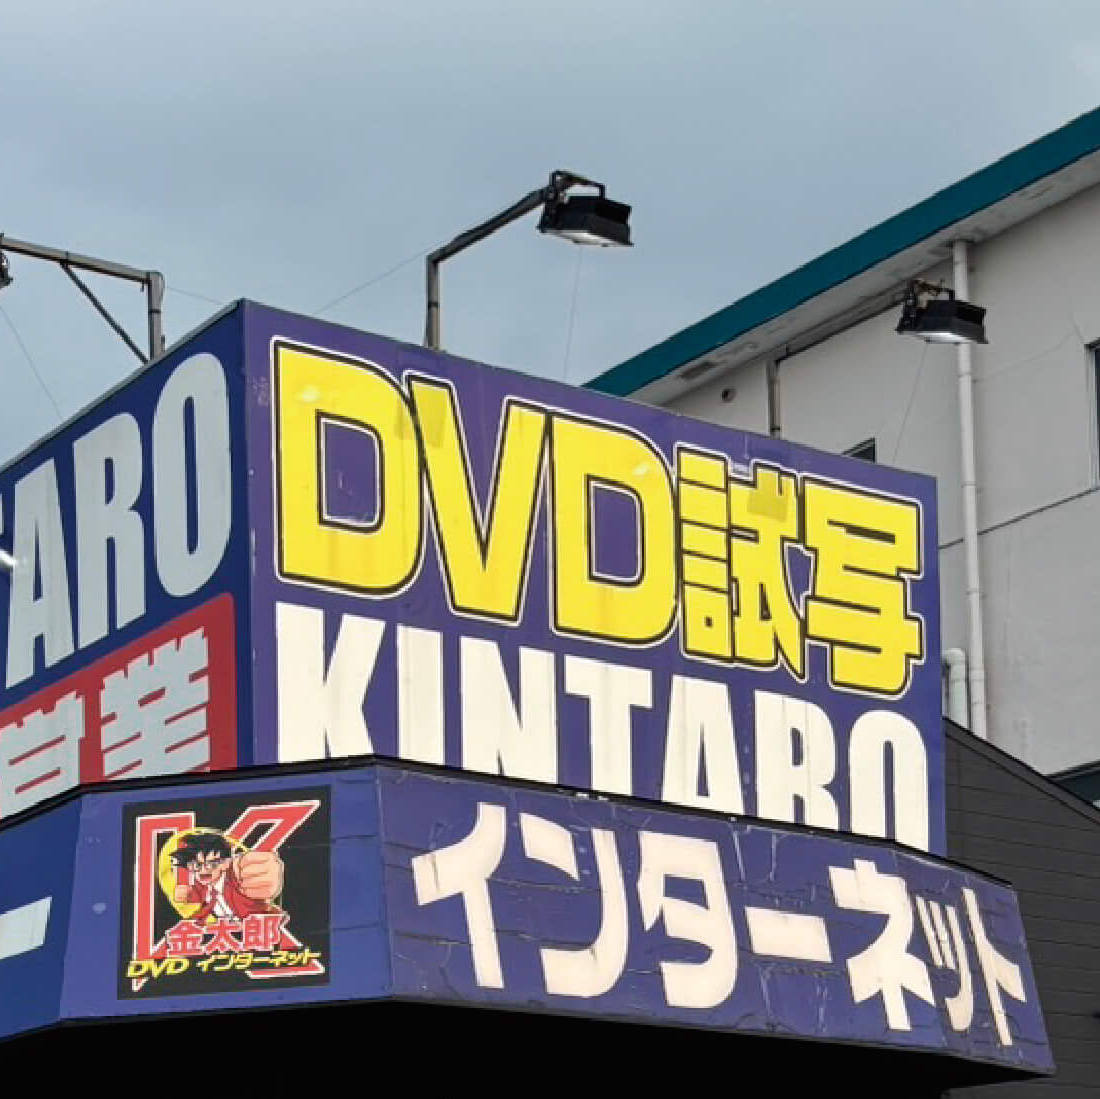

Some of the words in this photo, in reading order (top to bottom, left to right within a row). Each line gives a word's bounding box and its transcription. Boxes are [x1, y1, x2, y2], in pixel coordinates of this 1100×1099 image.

[272, 337, 924, 697] DVD試写
[276, 602, 929, 854] KINTARO
[127, 956, 190, 979] DVD
[197, 947, 322, 973] インターネット
[167, 913, 285, 957] 金太郎
[411, 802, 1027, 1047] インターネット
